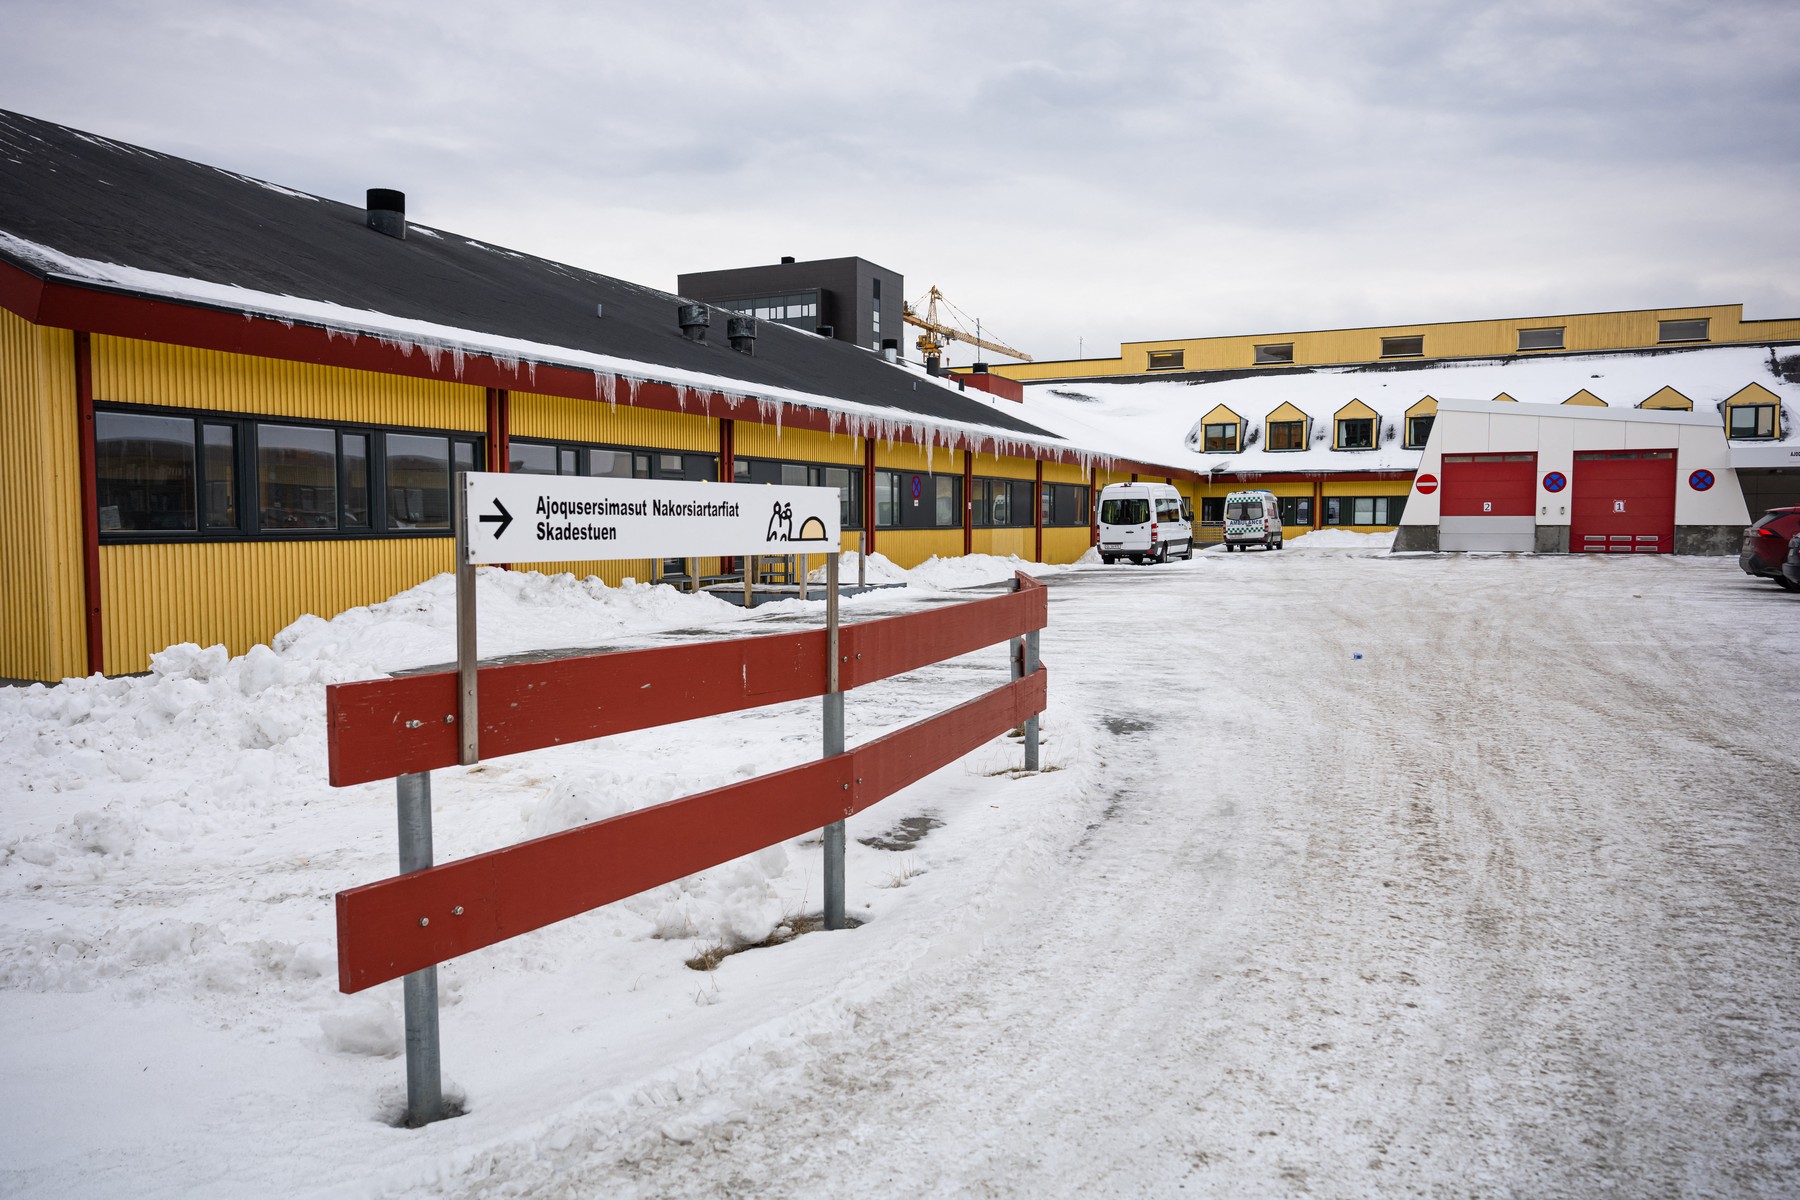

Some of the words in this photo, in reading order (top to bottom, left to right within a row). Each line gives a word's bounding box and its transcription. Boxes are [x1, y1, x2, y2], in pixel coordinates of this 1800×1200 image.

[536, 495, 647, 520] Ajoqusersimasut
[652, 499, 739, 517] Nakorsiartarfiat
[536, 521, 617, 541] Skadestuen
